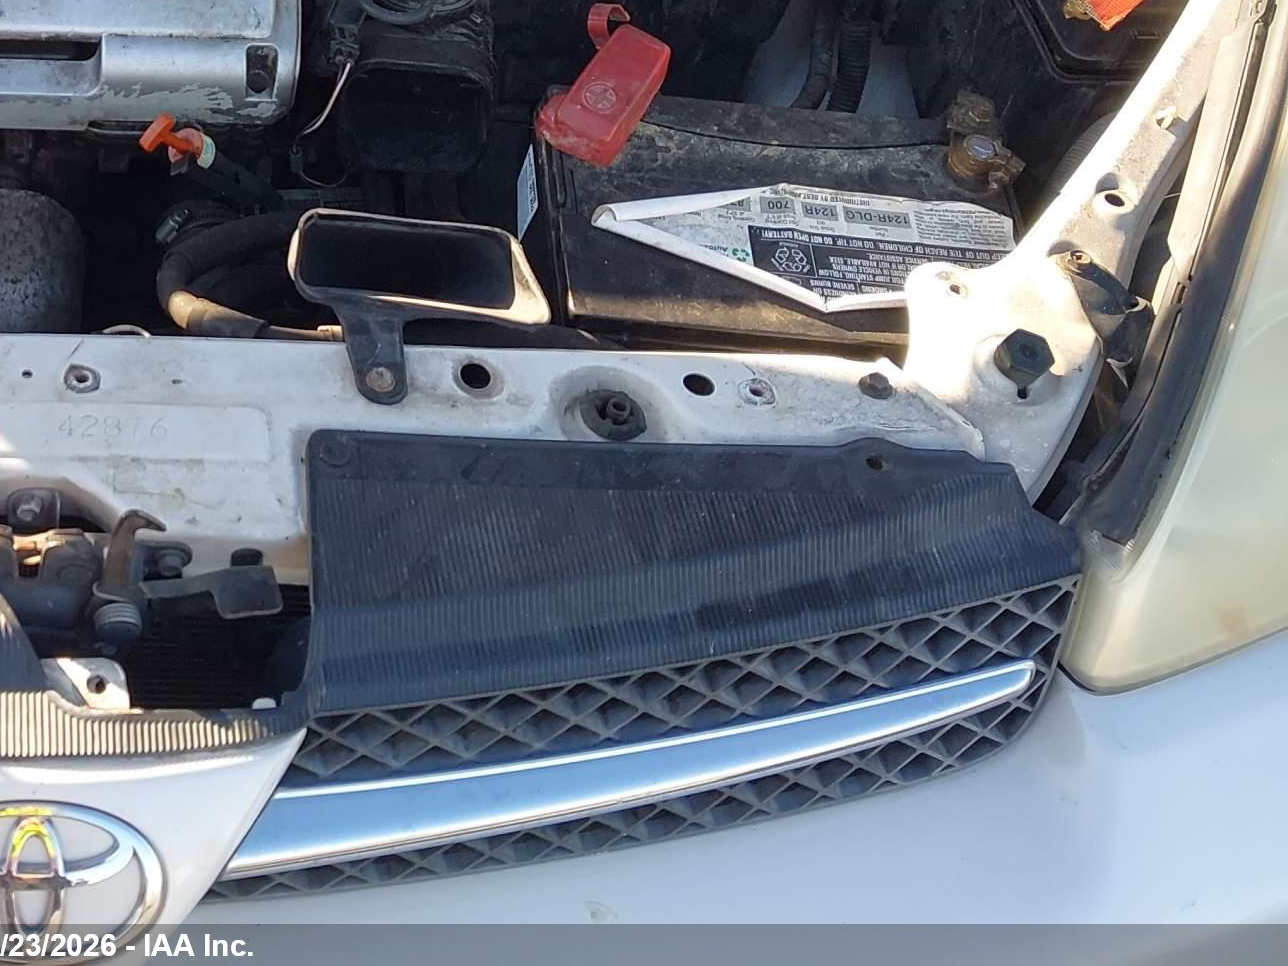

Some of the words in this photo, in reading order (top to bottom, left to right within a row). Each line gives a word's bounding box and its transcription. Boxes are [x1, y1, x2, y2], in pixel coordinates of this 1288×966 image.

[767, 200, 790, 210] 700
[804, 205, 834, 218] 124R
[845, 210, 908, 225] 124R-DLG
[761, 229, 793, 239] BATTERY!
[793, 231, 809, 242] OPEN
[810, 235, 823, 244] NOT
[824, 236, 833, 245] DO
[849, 239, 863, 248] NOT
[864, 240, 874, 249] DO
[924, 247, 948, 255] REACH
[975, 251, 990, 259] OUT
